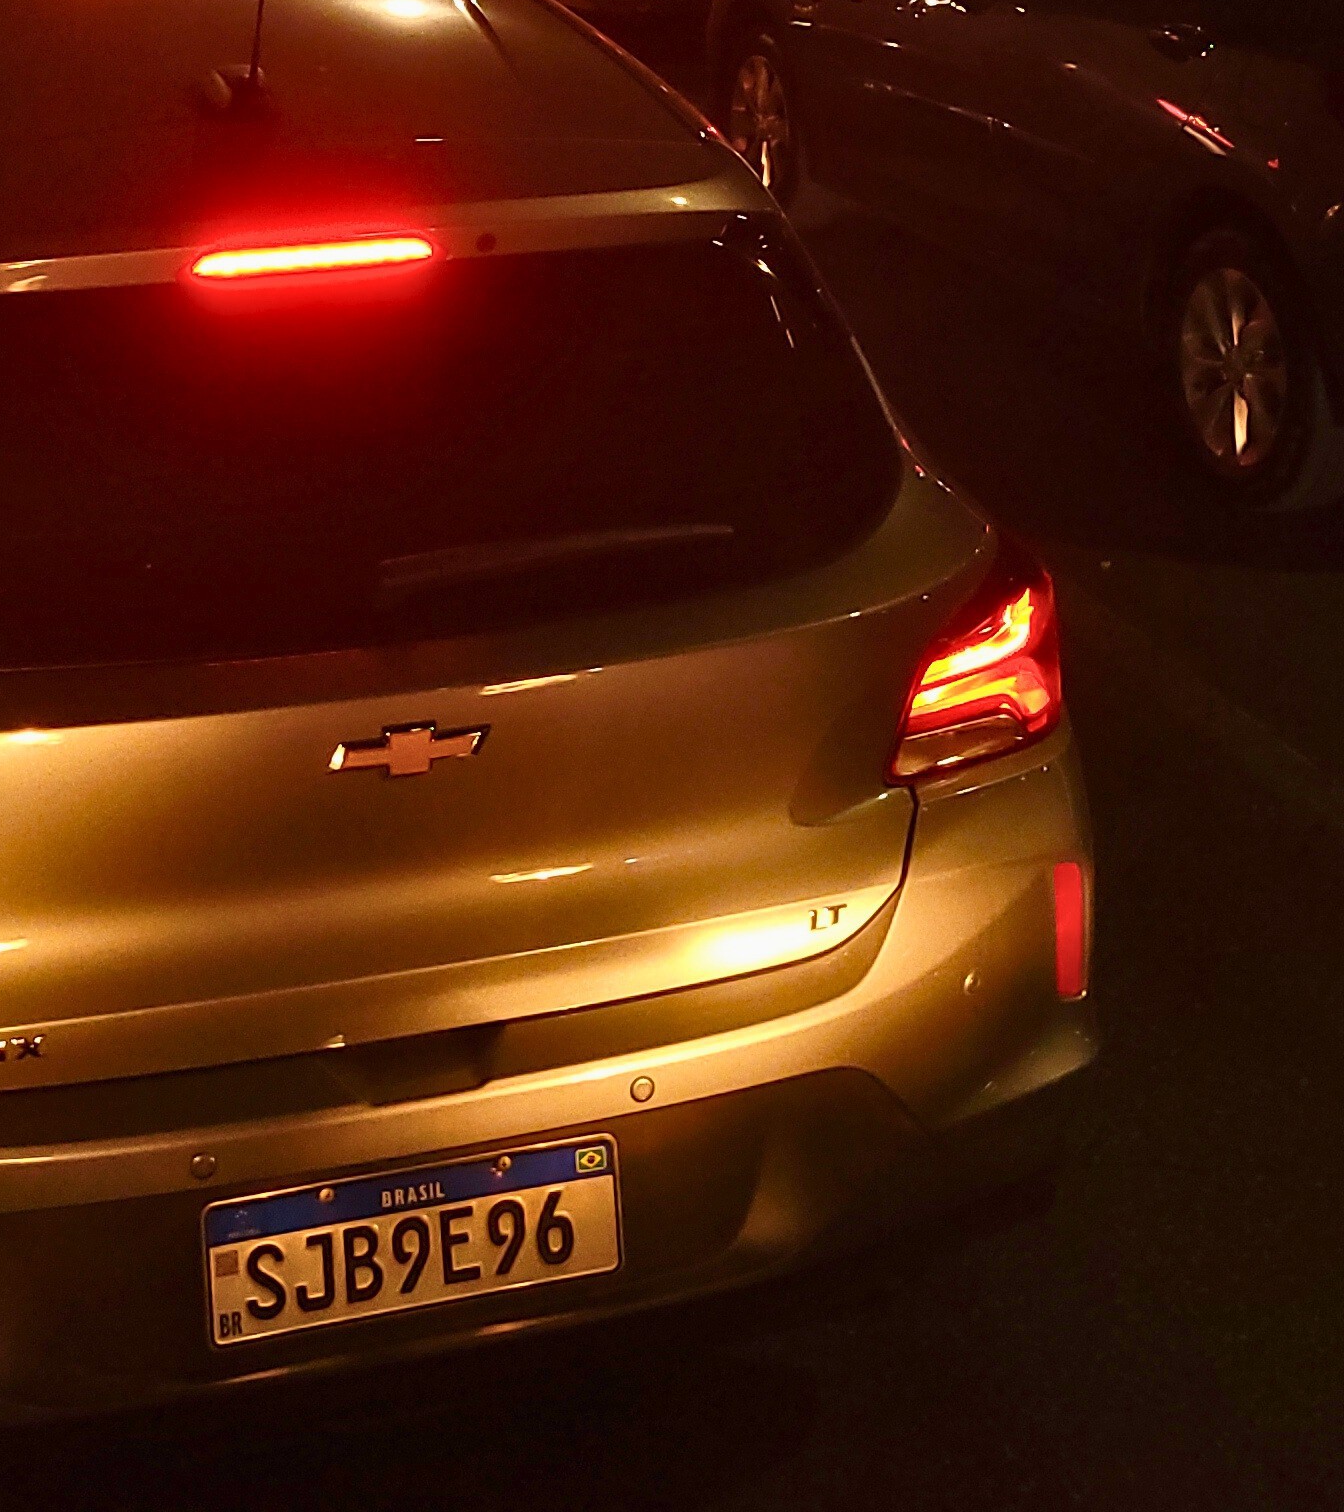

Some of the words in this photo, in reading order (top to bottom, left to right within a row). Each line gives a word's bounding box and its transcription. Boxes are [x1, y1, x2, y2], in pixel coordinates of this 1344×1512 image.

[808, 903, 848, 931] LT
[381, 1181, 446, 1209] BRASIL
[245, 1190, 576, 1320] SJB9E96
[219, 1311, 244, 1338] BR
